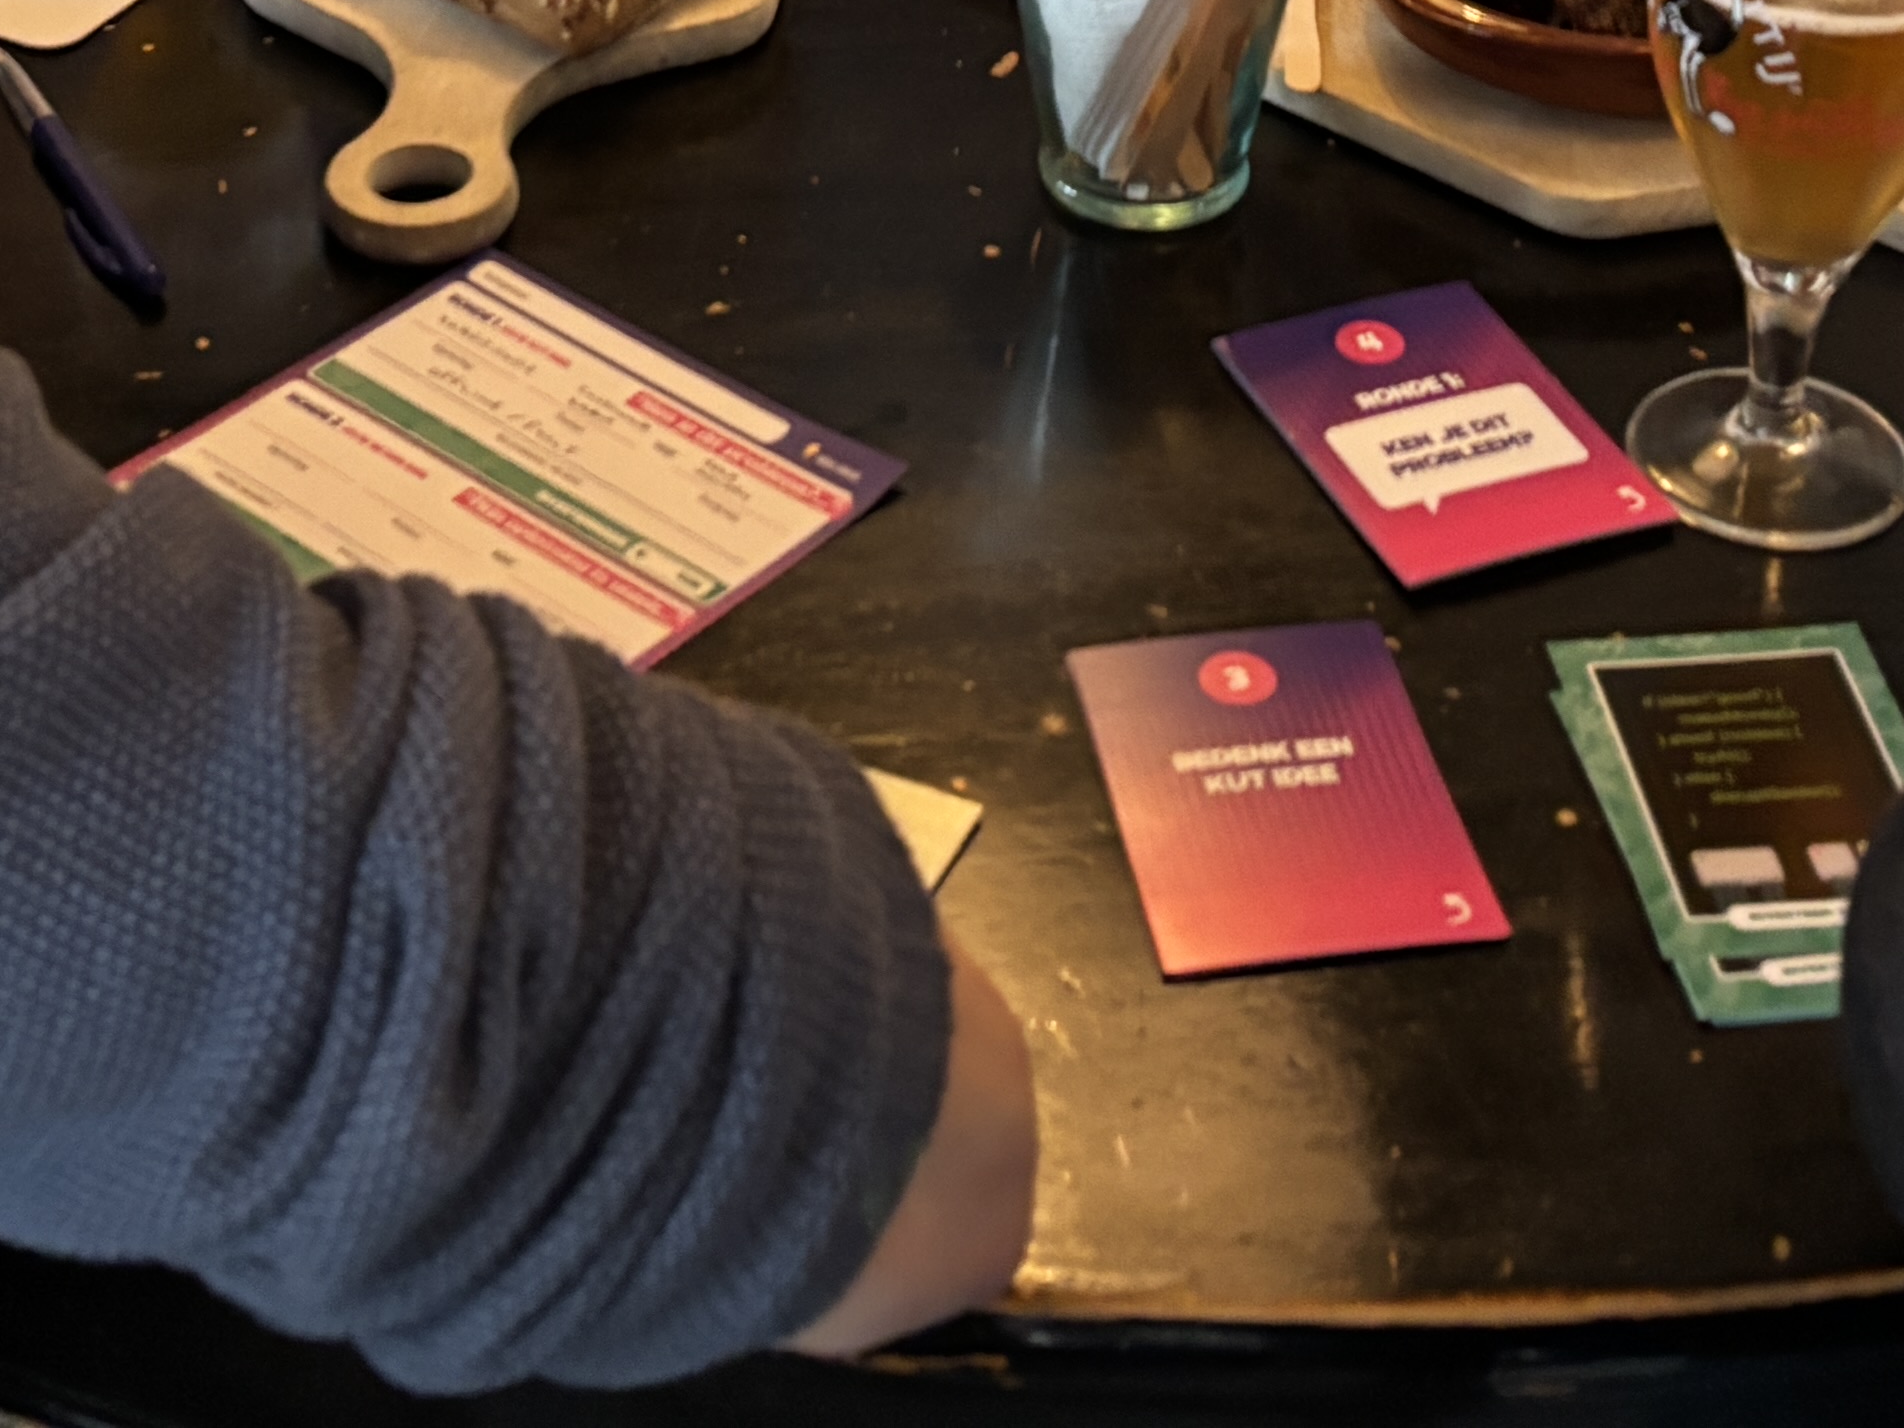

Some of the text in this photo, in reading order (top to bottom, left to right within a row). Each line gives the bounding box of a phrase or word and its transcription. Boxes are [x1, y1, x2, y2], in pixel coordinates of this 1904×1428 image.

[1356, 330, 1385, 353] 4
[1353, 375, 1446, 412] RONDE
[1380, 411, 1511, 457] KEN JE DIT
[1389, 429, 1536, 480] PROBLEEM?
[1171, 734, 1355, 775] BEDENK EEN
[1201, 761, 1341, 797] KUT IDEE
